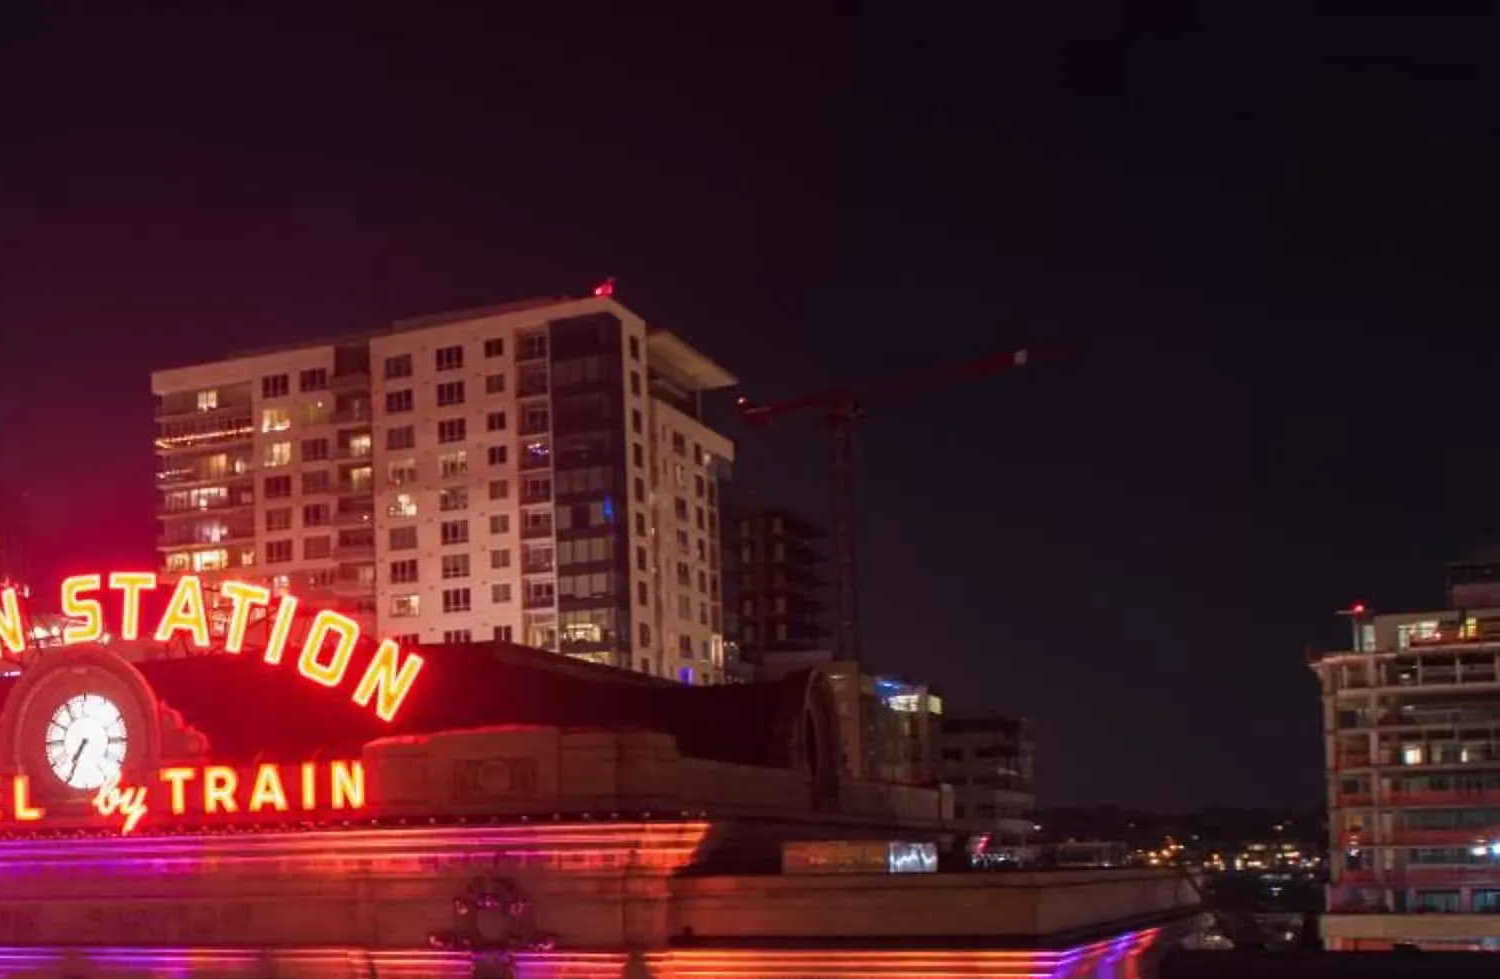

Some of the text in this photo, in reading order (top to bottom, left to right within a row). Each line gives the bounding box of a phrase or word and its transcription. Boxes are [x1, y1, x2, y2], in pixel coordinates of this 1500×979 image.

[61, 572, 424, 722] STATION
[92, 774, 148, 835] by
[161, 759, 365, 816] TRAIN
